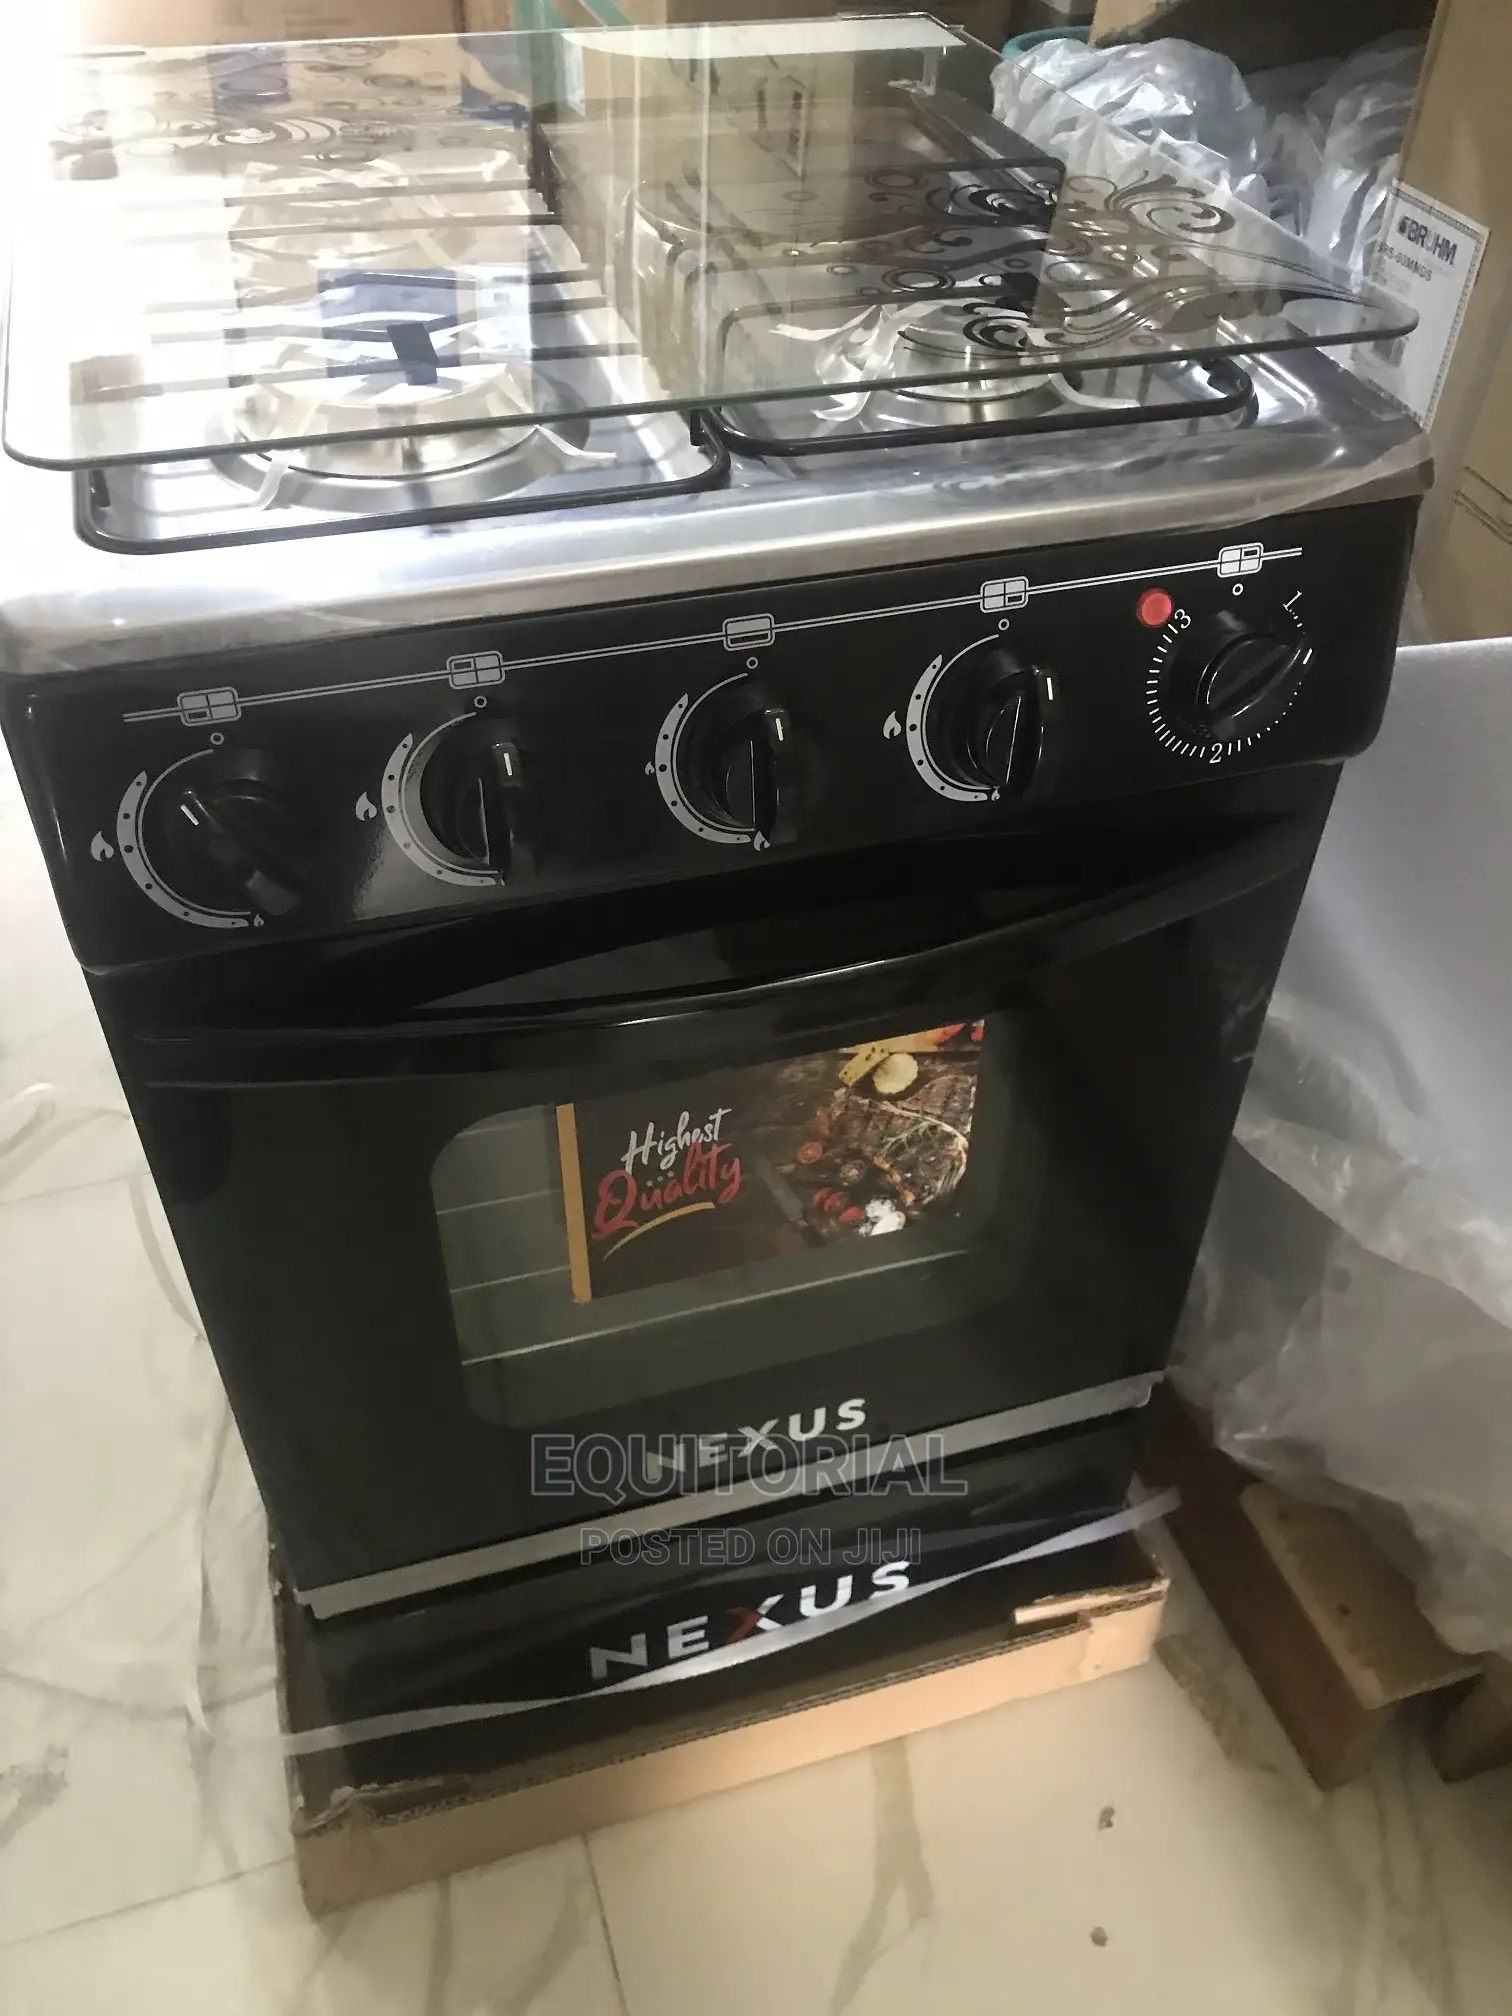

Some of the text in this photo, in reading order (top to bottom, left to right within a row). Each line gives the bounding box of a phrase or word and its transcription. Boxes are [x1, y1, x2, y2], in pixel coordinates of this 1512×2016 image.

[1174, 608, 1192, 629] 3
[1282, 590, 1302, 610] 1
[1209, 743, 1224, 763] 2
[620, 1107, 733, 1175] Highest
[590, 1142, 741, 1241] Quality
[647, 1397, 867, 1481] NEXUS
[589, 1560, 911, 1681] NEXUS
